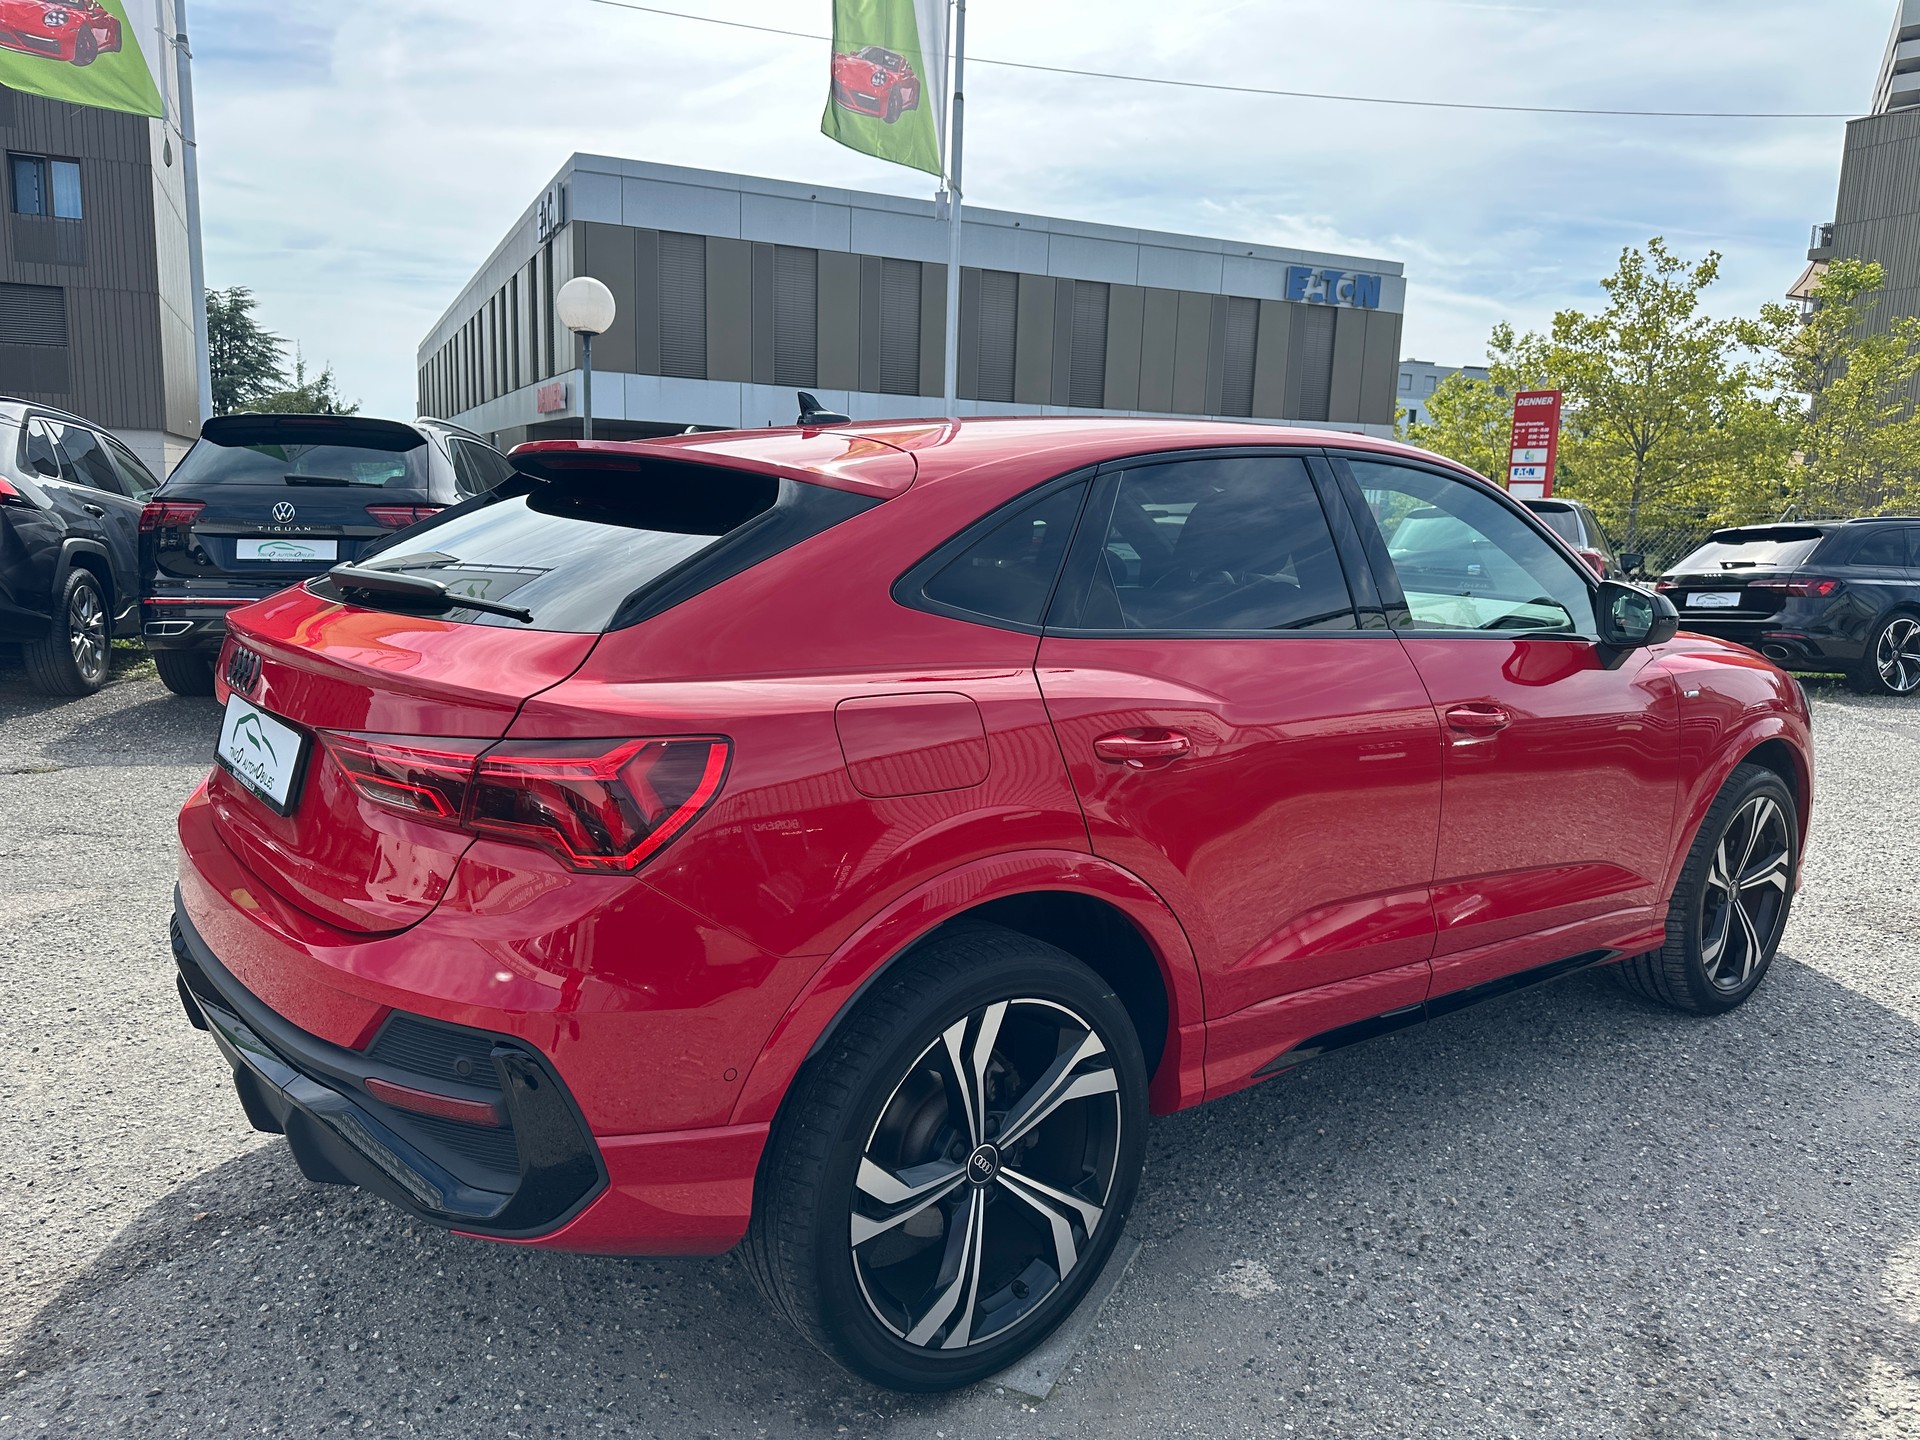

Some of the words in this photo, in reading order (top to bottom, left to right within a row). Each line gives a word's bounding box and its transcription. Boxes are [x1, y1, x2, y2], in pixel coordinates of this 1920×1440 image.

[1285, 266, 1381, 309] EATON
[1517, 397, 1554, 407] DENNER
[241, 758, 275, 790] AUTOMOBILES
